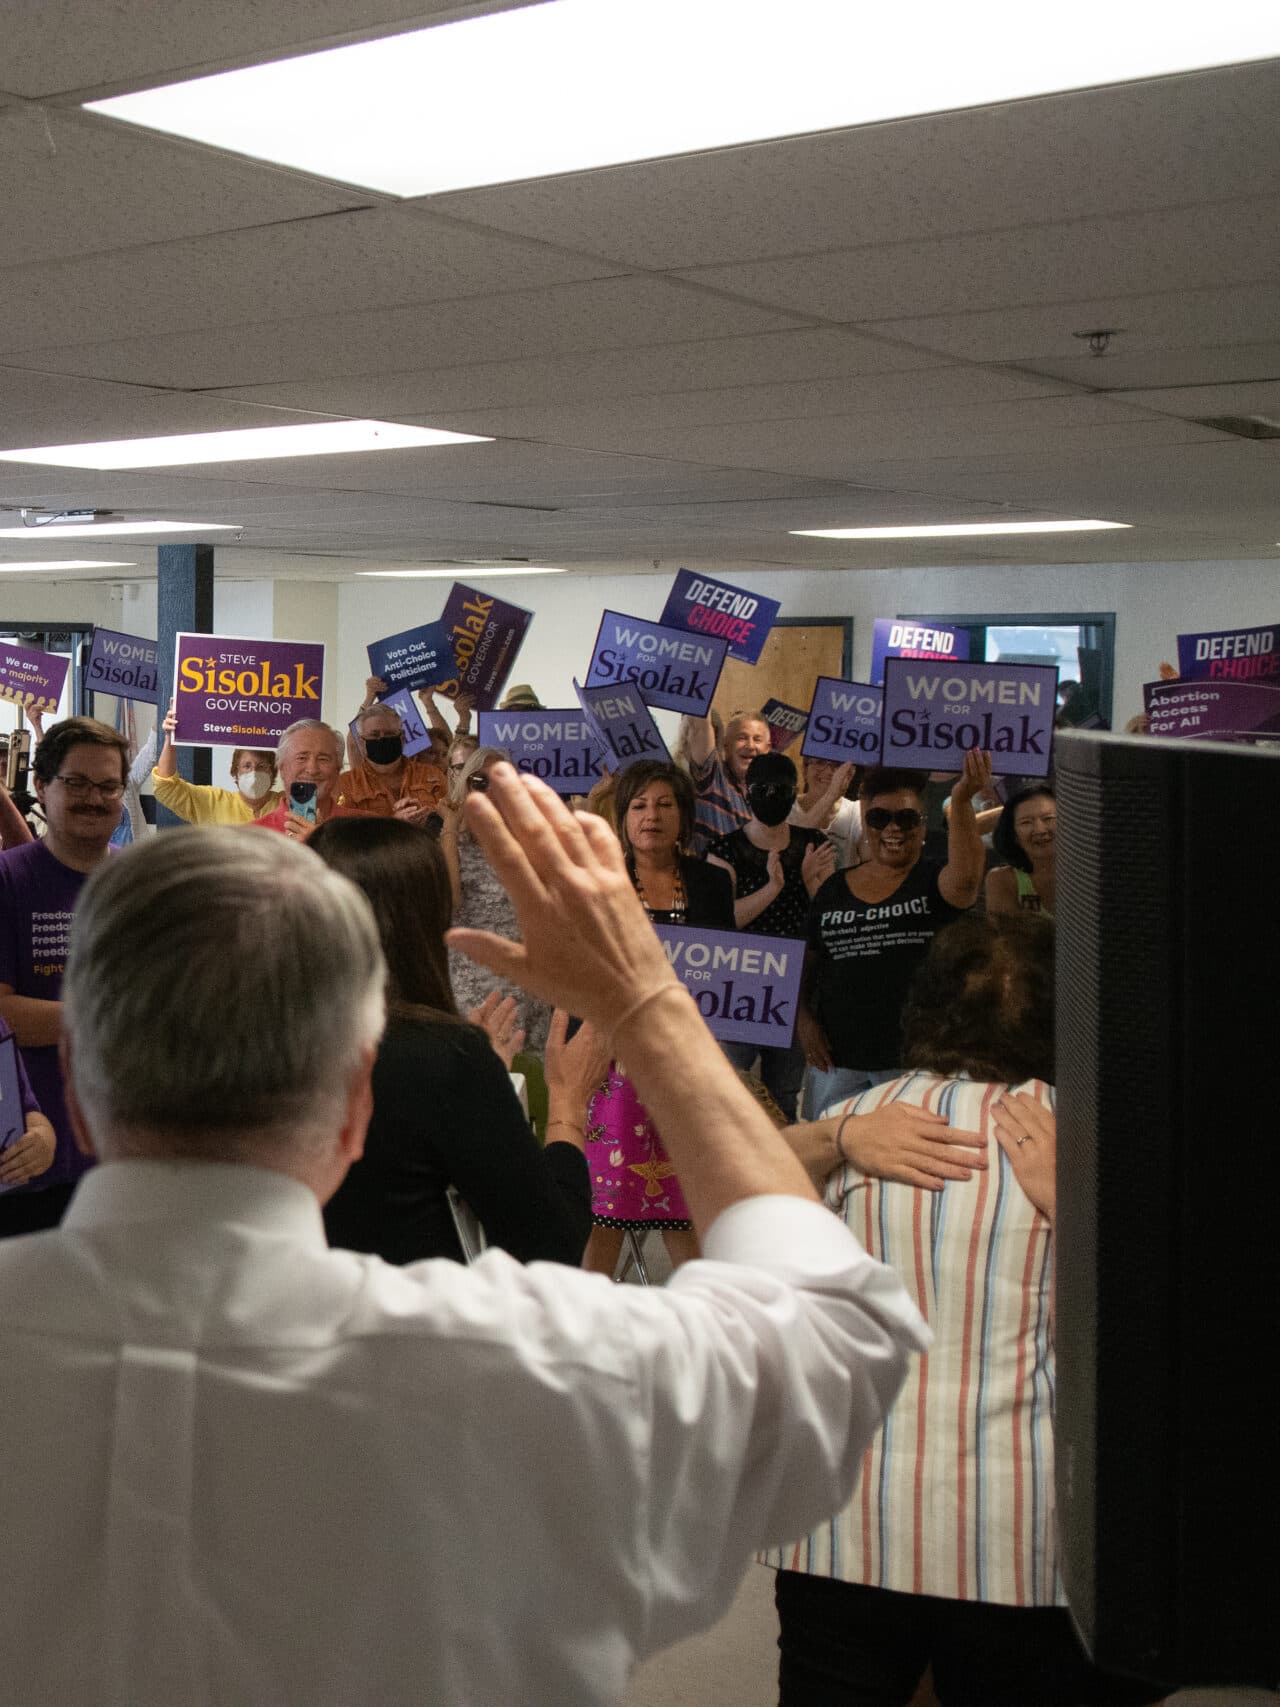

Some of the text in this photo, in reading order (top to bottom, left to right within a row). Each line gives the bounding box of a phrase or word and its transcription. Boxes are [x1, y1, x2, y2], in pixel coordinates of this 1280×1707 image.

[684, 578, 758, 620] DEFEND
[687, 605, 756, 644] CHOICE
[436, 594, 494, 697] Ssolak
[615, 625, 713, 665] WOMEN
[888, 625, 954, 654] DEFEND
[1195, 631, 1274, 661] DEFEND
[220, 654, 256, 665] STEVE
[387, 641, 426, 660] Vote Out
[467, 621, 499, 684] GOVERNOR
[636, 653, 657, 663] FOR
[6, 656, 39, 672] We are
[384, 650, 437, 673] Anti-Choice
[390, 661, 437, 681] Politicians
[9, 668, 49, 687] majority
[179, 656, 320, 699] Sisolak
[594, 649, 709, 701] Sisolak
[906, 675, 1041, 706] WOMEN
[1149, 690, 1220, 708] Abortion
[205, 698, 292, 714] GOVERNOR
[944, 704, 971, 714] FOR
[1151, 705, 1208, 719] Access
[768, 707, 808, 732] DEFEN
[855, 716, 875, 726] FOR
[1150, 716, 1201, 732] For All
[811, 715, 880, 752] Siso
[890, 709, 1046, 754] Sisolak
[524, 743, 544, 751] FOR
[820, 896, 931, 926] PRO-CHOICE
[32, 922, 72, 933] Freedo
[32, 934, 70, 945] Freedo
[32, 946, 70, 957] Freedo
[685, 969, 712, 981] FOR
[690, 981, 790, 1026] olak
